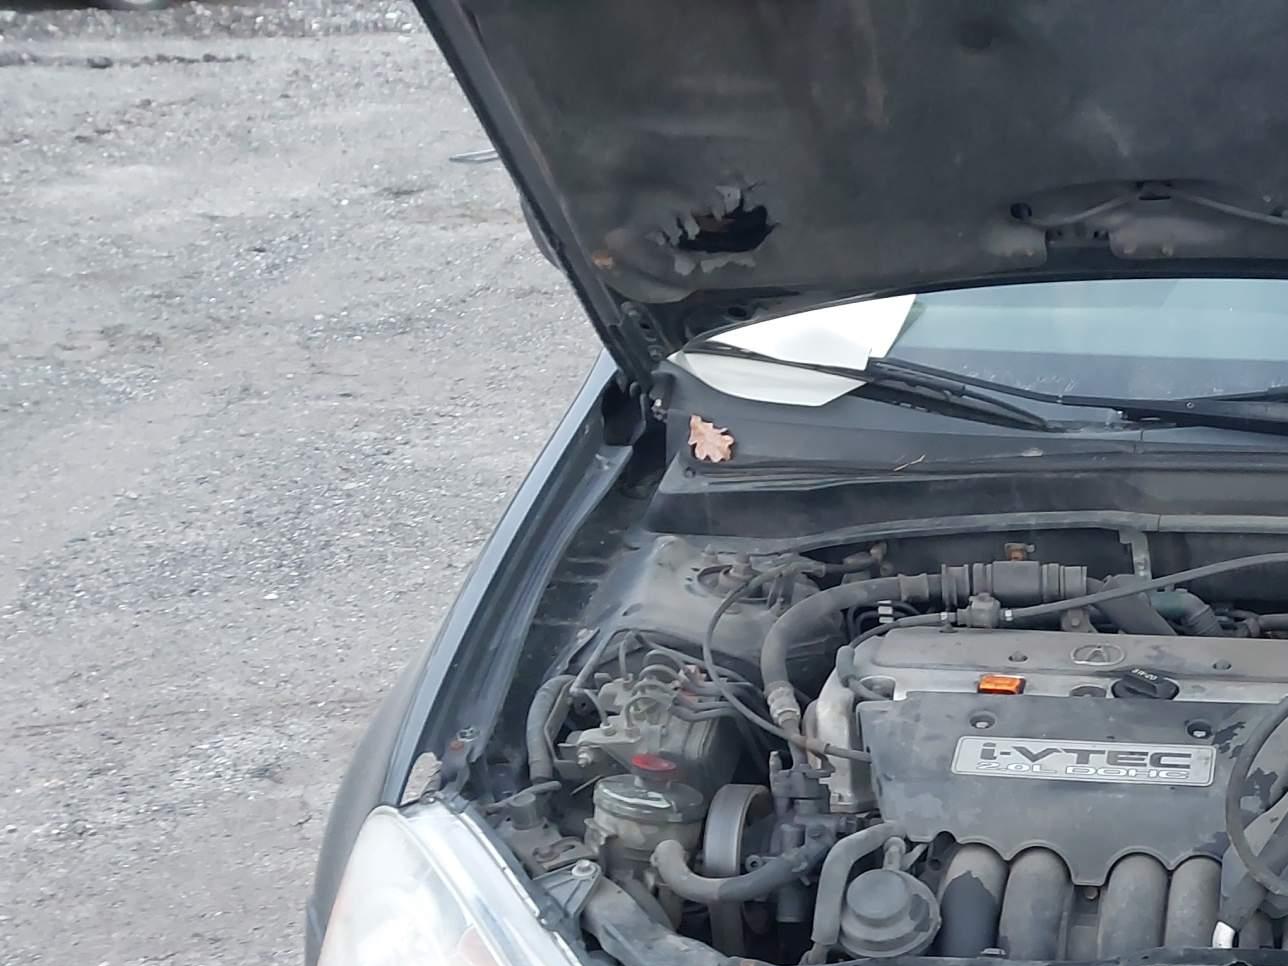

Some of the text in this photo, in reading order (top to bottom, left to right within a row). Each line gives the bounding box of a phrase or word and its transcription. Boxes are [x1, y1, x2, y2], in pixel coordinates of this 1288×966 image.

[980, 742, 1192, 770] i-VTEC
[976, 761, 1190, 780] 2.0L DOHC
